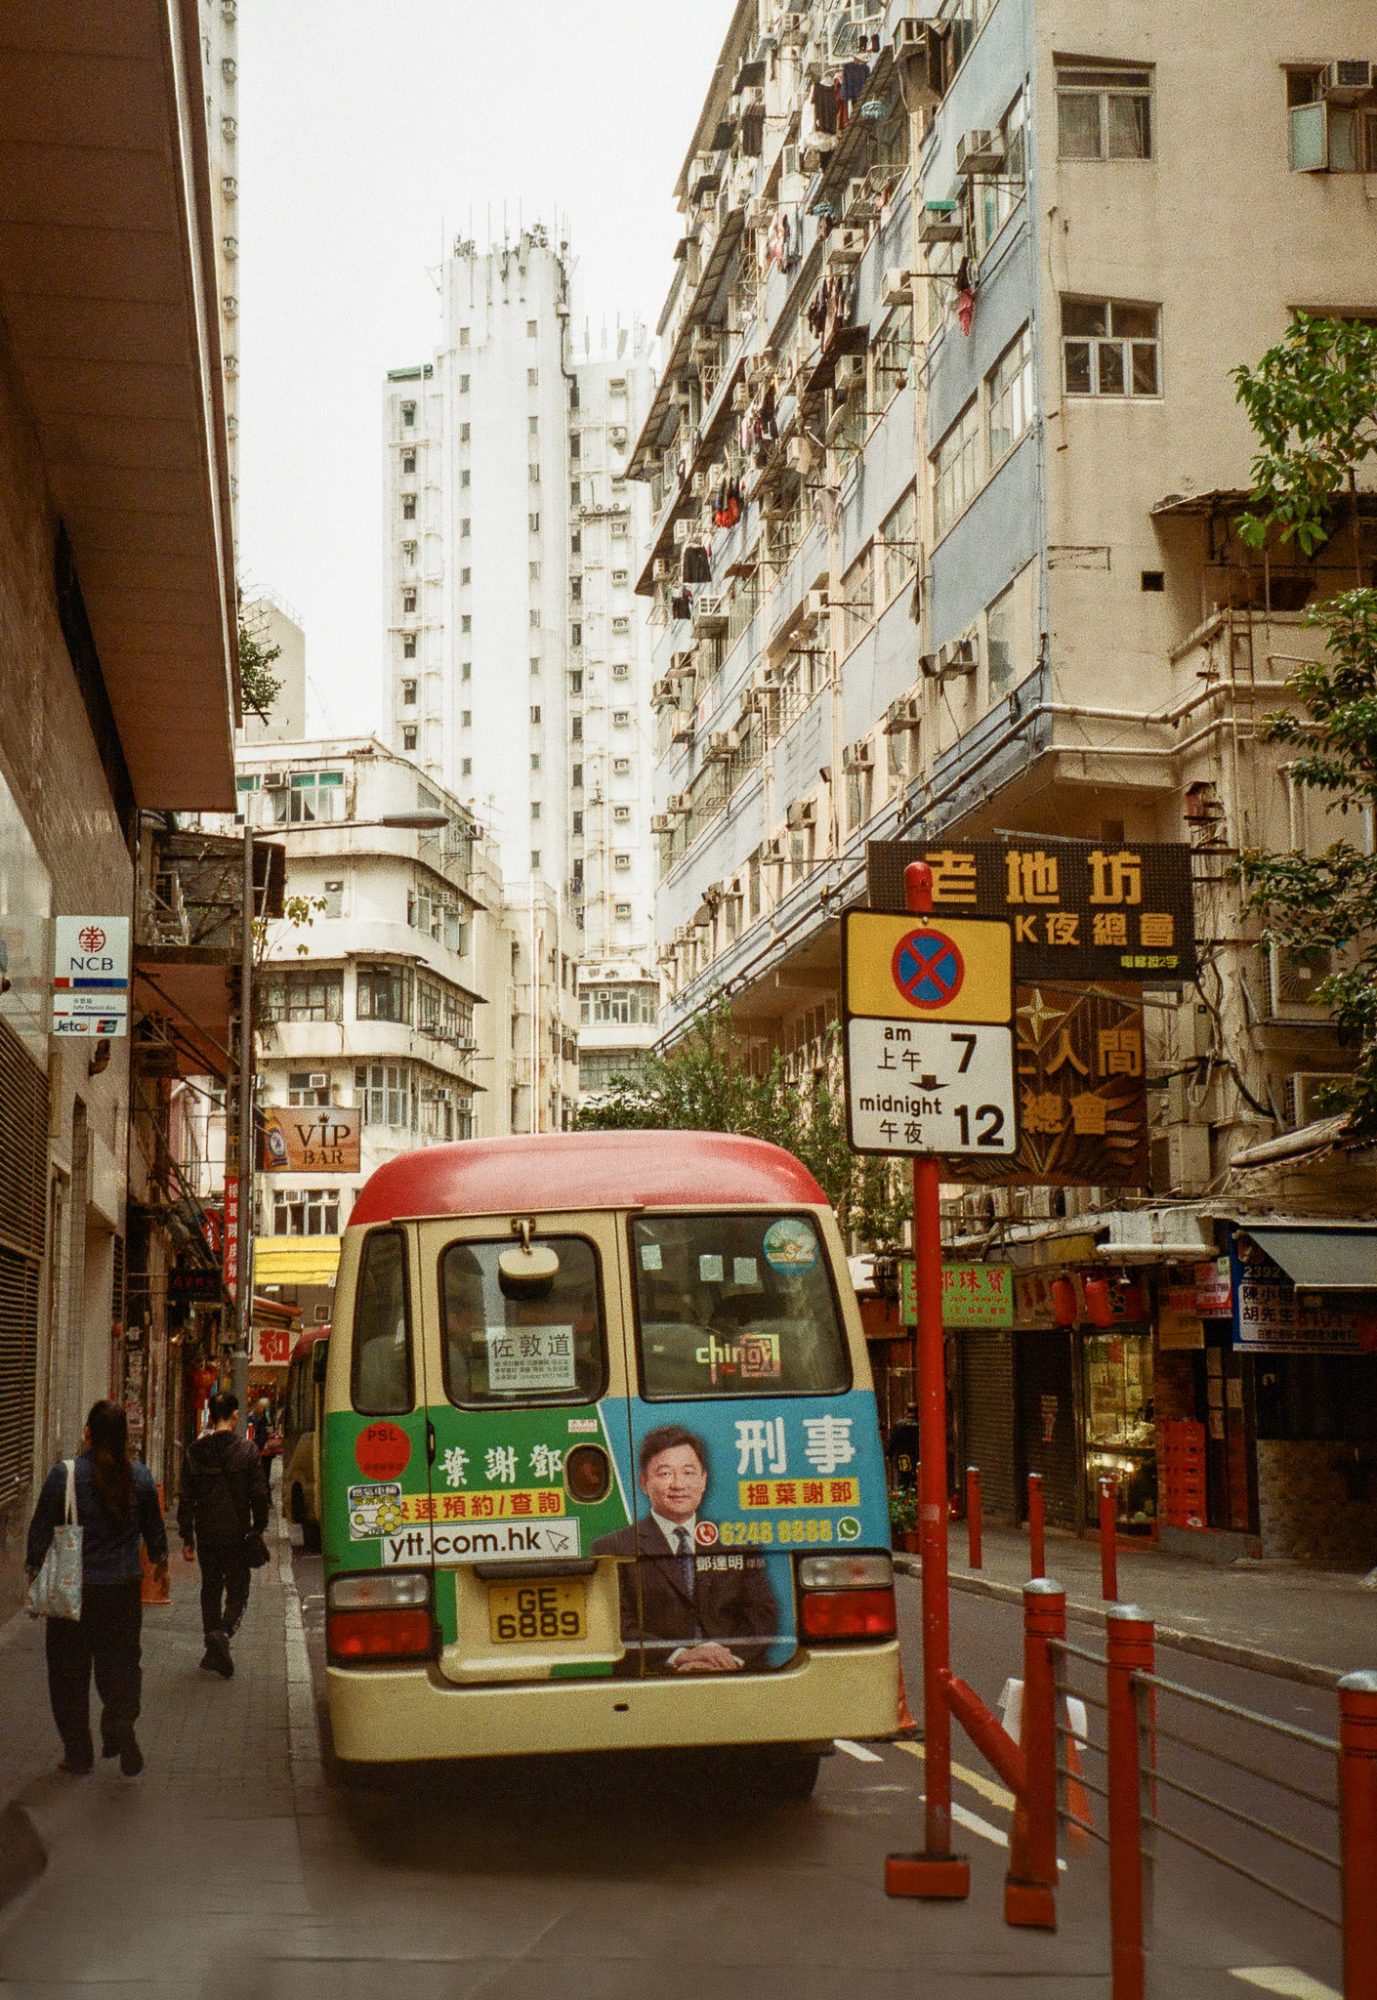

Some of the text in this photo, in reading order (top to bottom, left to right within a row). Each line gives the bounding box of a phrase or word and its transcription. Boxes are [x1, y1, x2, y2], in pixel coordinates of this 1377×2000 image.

[70, 957, 114, 971] NCB
[884, 1027, 911, 1041] am
[877, 1047, 922, 1072] 上午
[951, 1033, 977, 1073] 7
[859, 1094, 942, 1117] midnight
[294, 1124, 351, 1148] VIP
[880, 1119, 923, 1145] 午夜
[954, 1104, 1005, 1147] 12
[303, 1150, 344, 1164] BAR
[1243, 1306, 1294, 1323] 胡先生
[491, 1334, 570, 1359] 佐敦道
[367, 1429, 397, 1442] PSL
[735, 1415, 856, 1475] 刑事
[438, 1444, 563, 1488] 葉謝鄧
[389, 1526, 541, 1562] ytt.com.hk
[517, 1588, 557, 1612] GE
[498, 1612, 580, 1638] 6889
